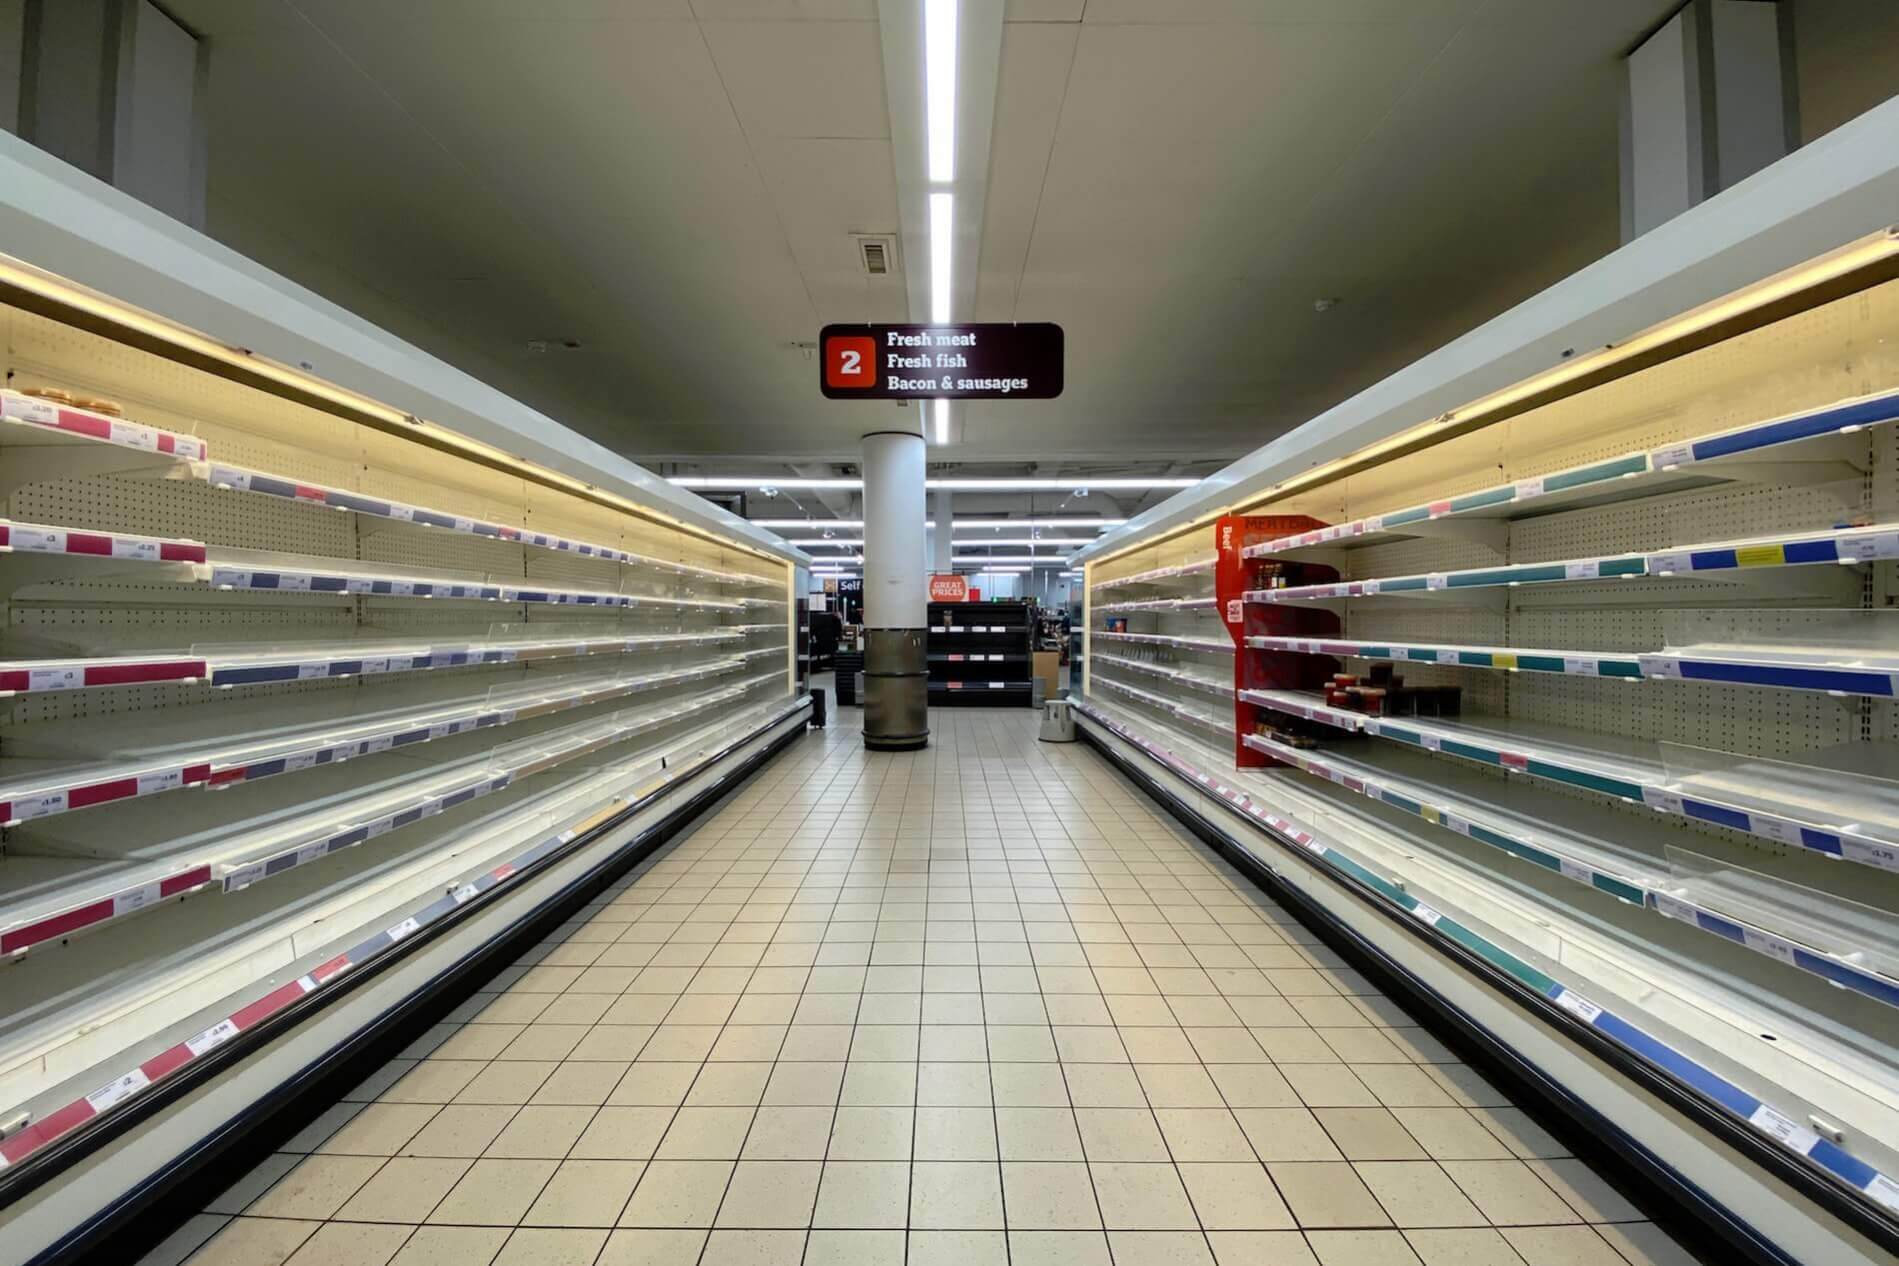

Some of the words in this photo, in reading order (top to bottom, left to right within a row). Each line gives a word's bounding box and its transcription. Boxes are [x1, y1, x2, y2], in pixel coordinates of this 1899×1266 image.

[887, 332, 932, 347] Fresh
[936, 333, 976, 347] meat
[840, 350, 861, 374] 2
[887, 354, 933, 368] Fresh
[936, 353, 968, 368] fish
[887, 376, 937, 391] Bacon
[941, 376, 953, 390] &
[957, 377, 1028, 393] sausages
[1222, 526, 1233, 550] Beef
[841, 580, 861, 591] Self
[932, 589, 964, 597] PRICES
[933, 581, 962, 590] GREAT
